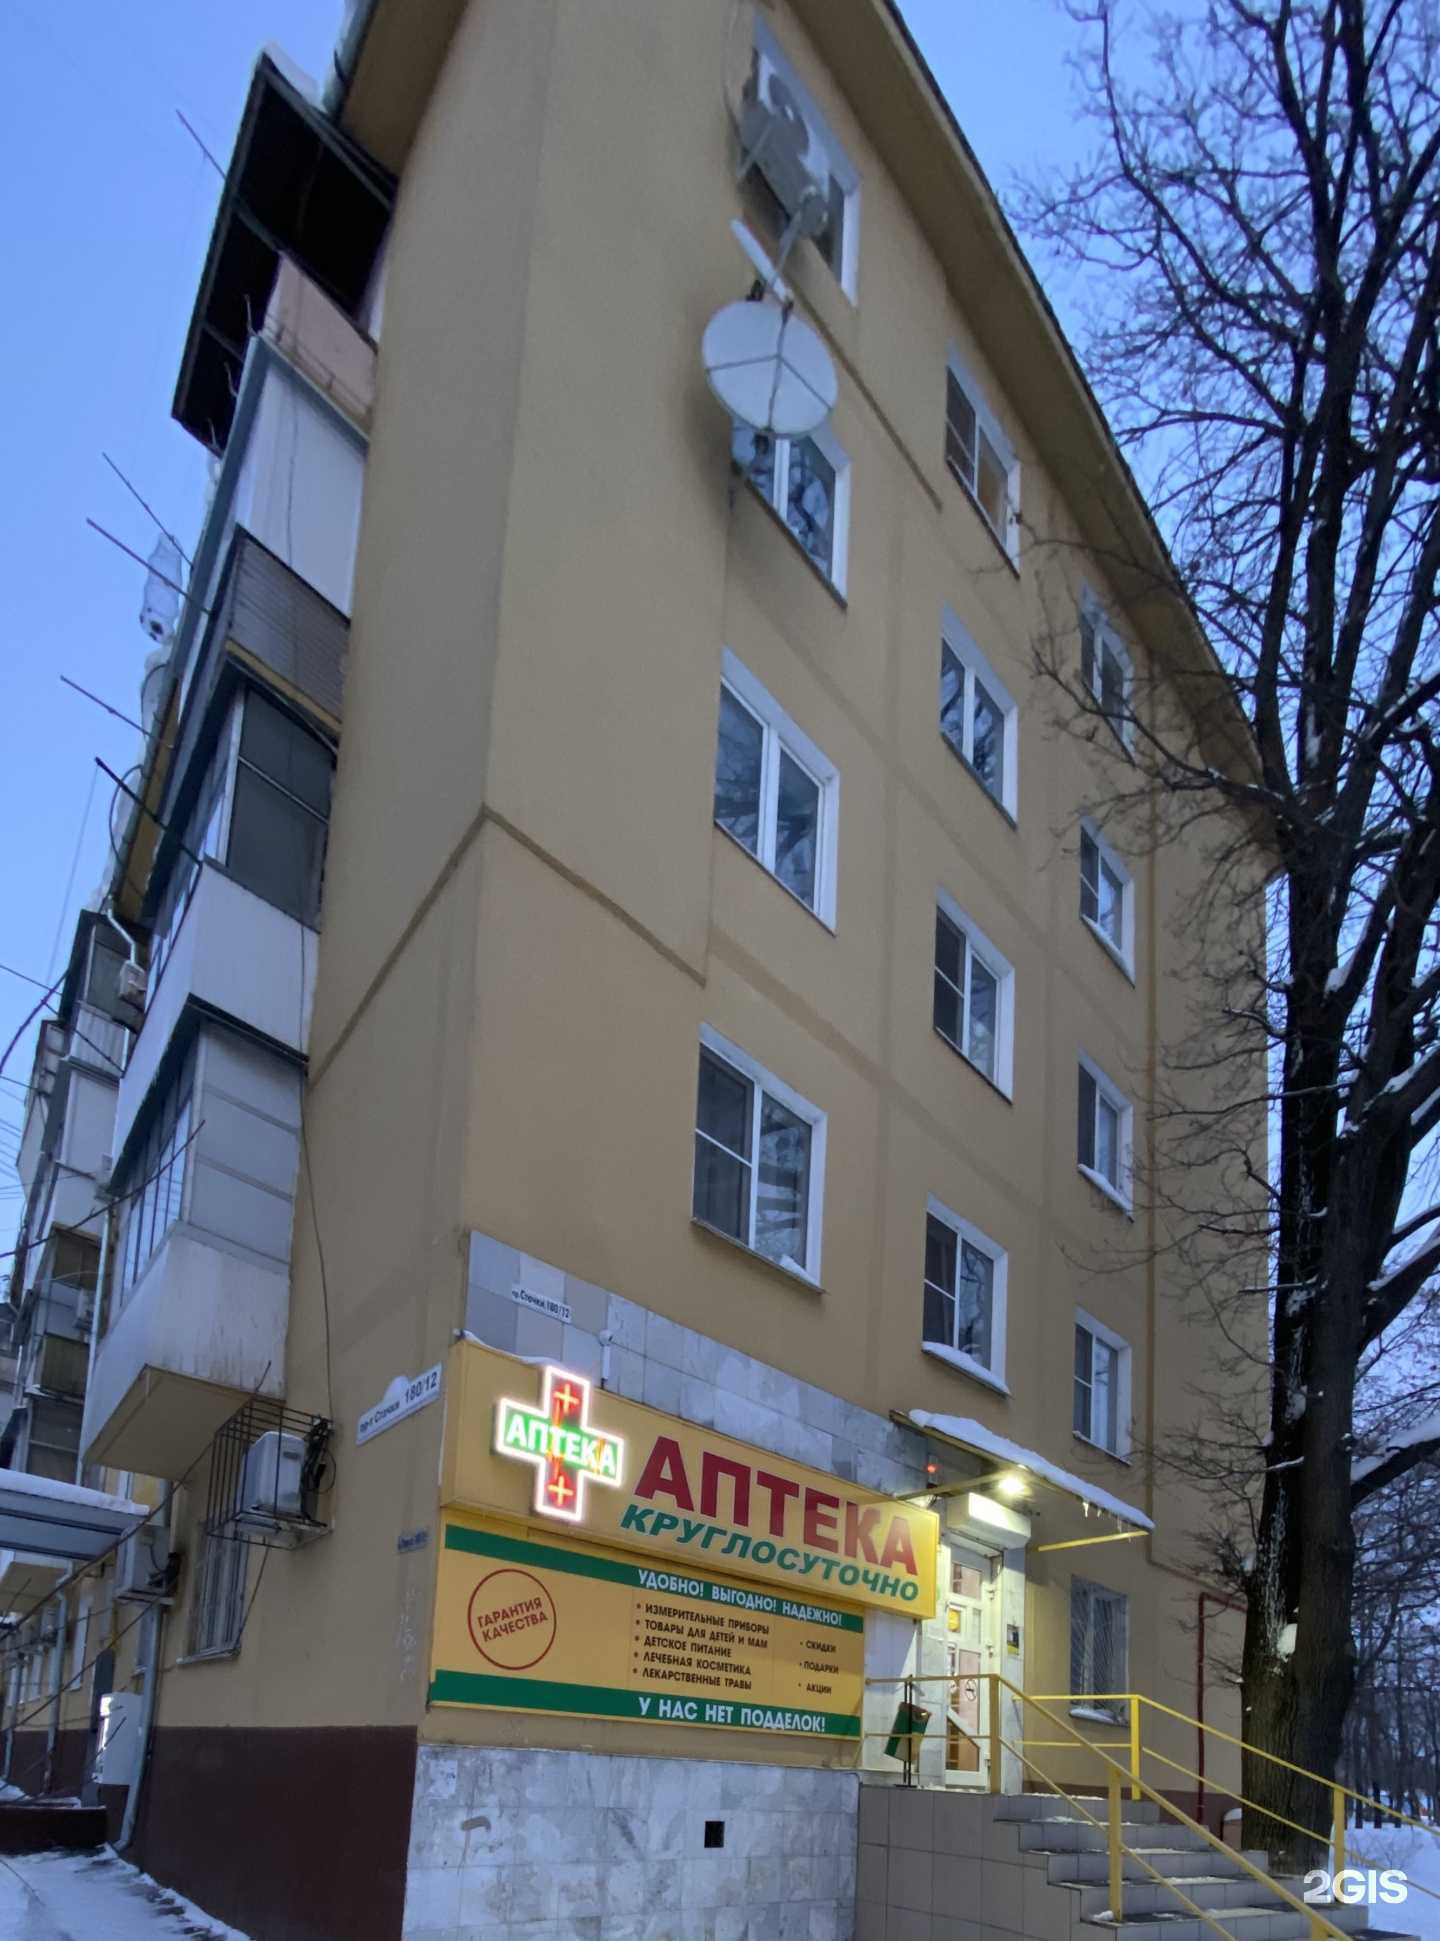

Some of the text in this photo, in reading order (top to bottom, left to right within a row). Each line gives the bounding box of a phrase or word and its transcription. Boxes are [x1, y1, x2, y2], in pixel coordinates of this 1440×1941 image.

[505, 1413, 617, 1477] АПТЕКА
[633, 1436, 919, 1577] АПТЕКА
[620, 1503, 919, 1602] КРУГЛОСУТОЧНО
[477, 1597, 543, 1628] ГАРАНТИЯ
[638, 1569, 843, 1626] УДОБНО! ВЫГОДНО! НАДЕЖНО!
[481, 1611, 549, 1643] КАЧЕСТВА
[644, 1619, 768, 1649] ТОВАРЫ ДЛЯ ДЕТЕЙ И МАМ
[645, 1603, 770, 1635] ИЗМЕРИТЕЛЬНЫЕ ПРИБОРЫ
[643, 1635, 732, 1658] ДЕТСКОЕ ПИТАНИЕ
[805, 1640, 837, 1653] СКИДКИ
[642, 1667, 752, 1691] ЛЕКАРСТВЕННЫЕ ТРАВЫ
[643, 1651, 752, 1676] ЛЕЧЕБНАЯ КОСМЕТИКА
[803, 1660, 839, 1675] ПОДАРКИ
[806, 1682, 832, 1696] АКЦИИ
[638, 1697, 826, 1733] У НАС НЕТ ПОДДЕЛОК!
